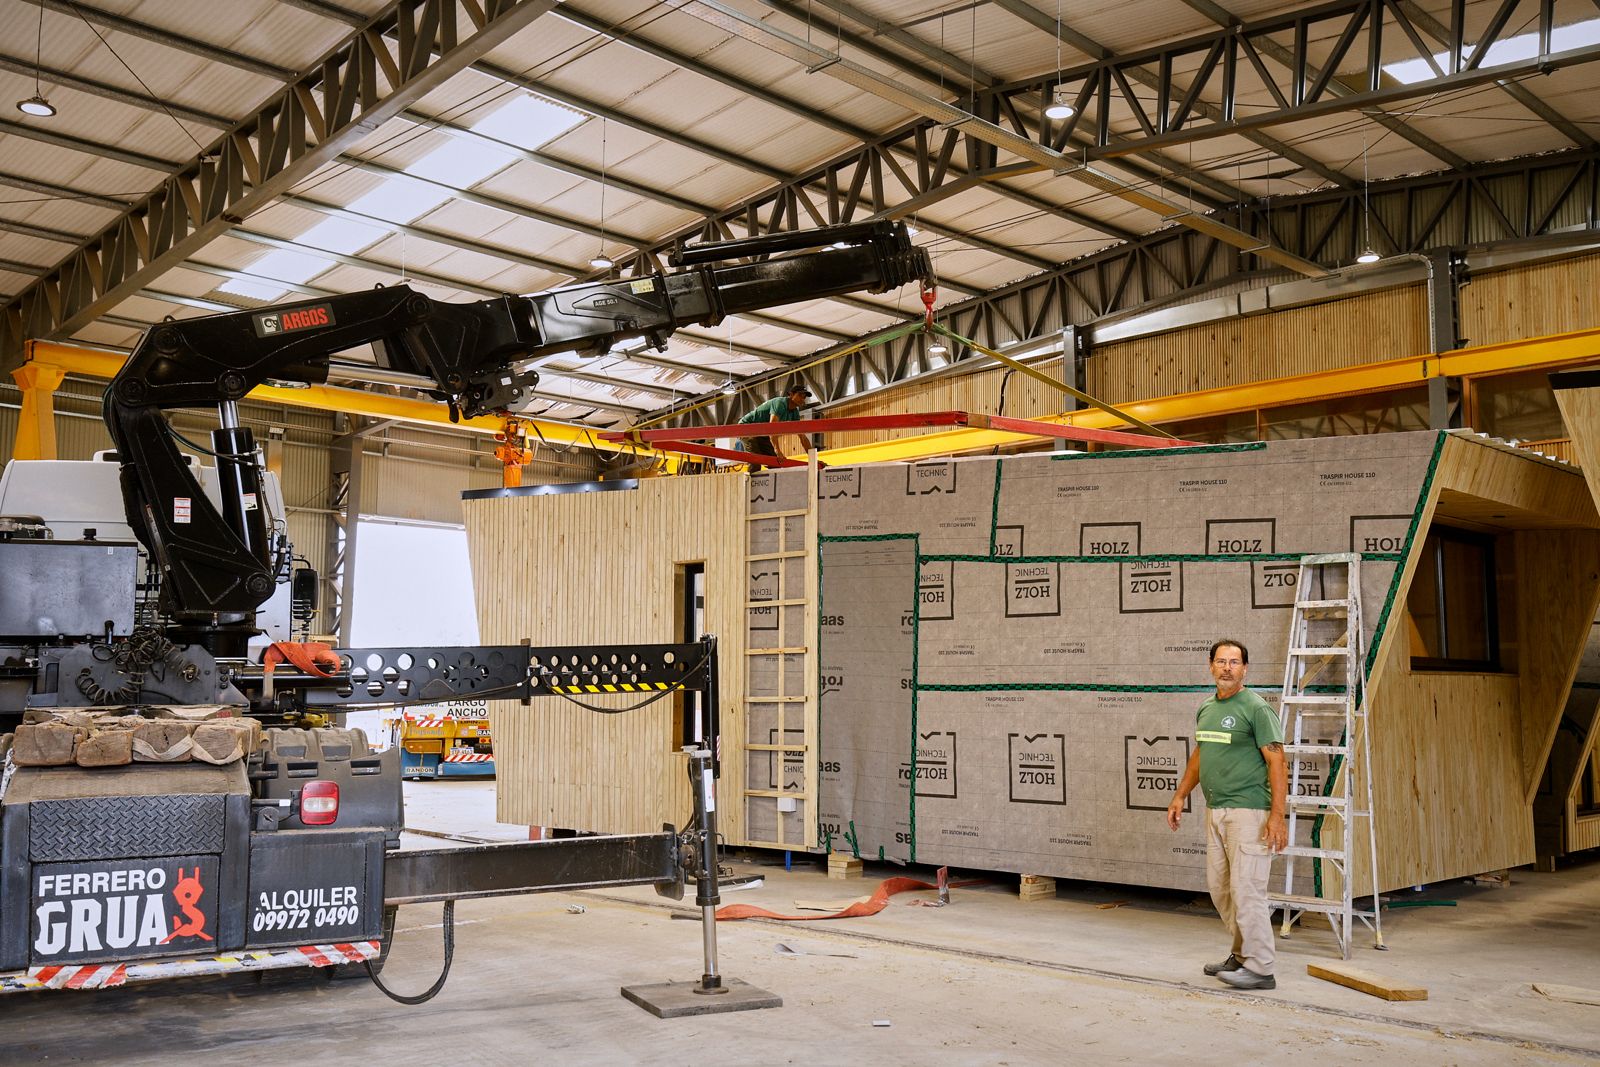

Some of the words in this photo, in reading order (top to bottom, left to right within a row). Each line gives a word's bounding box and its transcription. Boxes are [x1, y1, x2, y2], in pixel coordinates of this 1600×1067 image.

[282, 308, 329, 330] ARGOS
[825, 473, 853, 483] TECHNIC
[915, 468, 947, 478] TECHNIC
[1090, 542, 1130, 555] HOLZ
[1217, 539, 1262, 554] HOLZ
[1130, 560, 1171, 570] TECHNIC
[1014, 567, 1049, 577] TECHNIC
[1014, 585, 1050, 599] HOLZ
[1130, 579, 1172, 594] HOLZ
[447, 708, 487, 717] ANCHO
[915, 749, 947, 758] TECHNIC
[1018, 752, 1055, 762] TECHNIC
[1136, 756, 1178, 767] TECHNIC
[915, 767, 947, 780] HOLZ
[1018, 771, 1056, 785] HOLZ
[1136, 776, 1178, 791] HOLZ
[38, 867, 166, 897] FERRERO
[255, 886, 357, 911] ALQUILER
[252, 908, 311, 932] 09972
[314, 905, 359, 927] 0490
